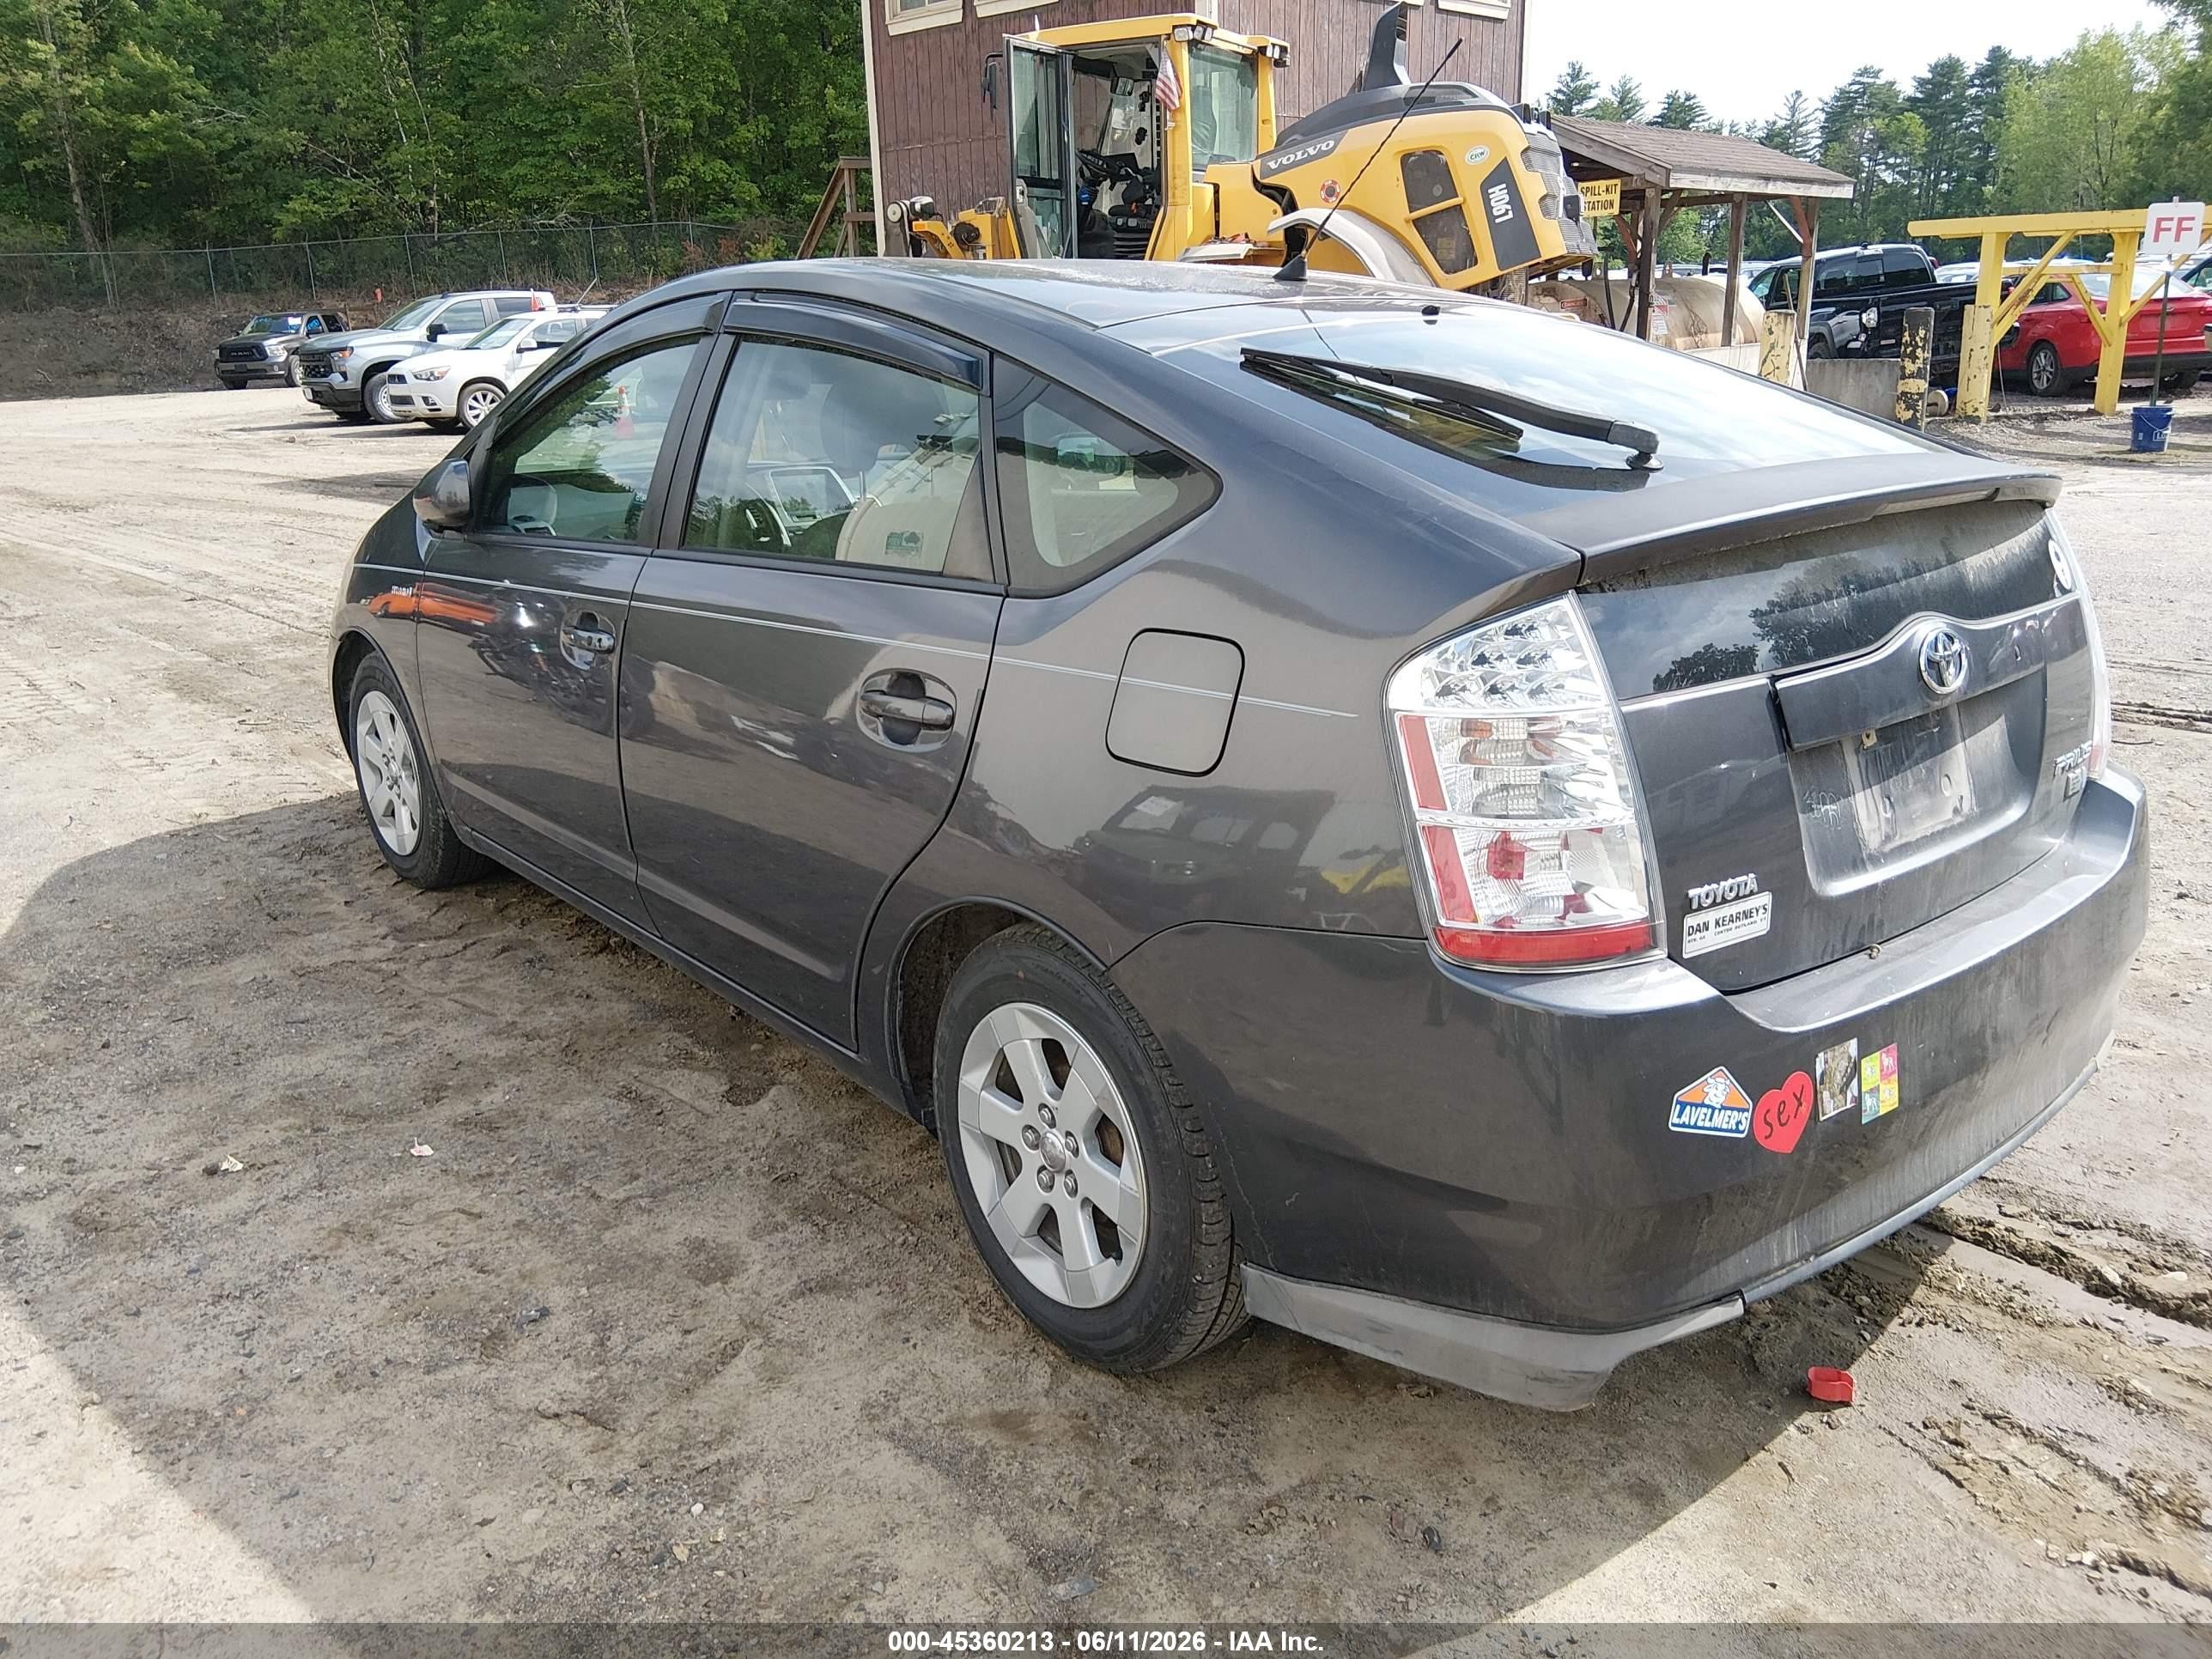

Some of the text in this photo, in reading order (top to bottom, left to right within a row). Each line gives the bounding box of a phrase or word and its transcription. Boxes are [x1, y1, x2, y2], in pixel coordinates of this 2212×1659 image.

[1267, 140, 1334, 170] VOLVO
[1487, 183, 1514, 223] L90H
[1580, 183, 1619, 198] SPILL-KIT
[2153, 216, 2196, 243] FF
[1688, 873, 1758, 909] TOYOTA
[1687, 903, 1768, 937] DAN KEARNEY'S
[1671, 1104, 1748, 1131] LAVELMER'S
